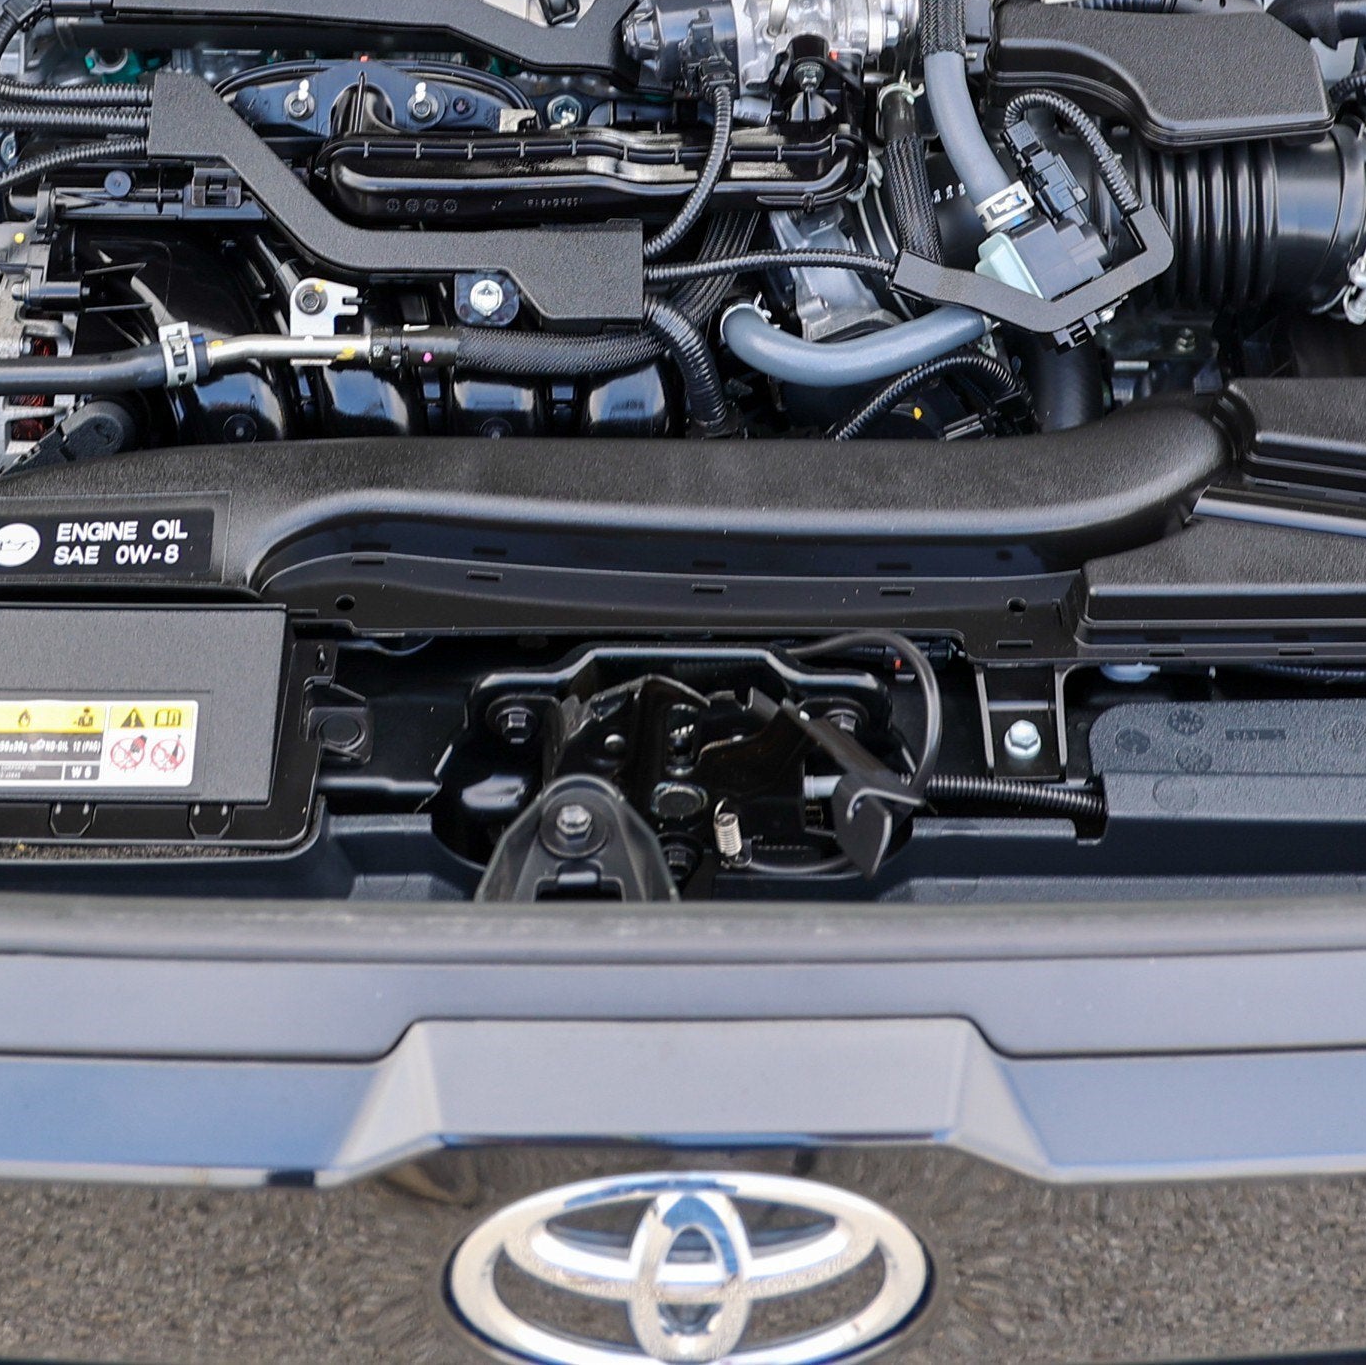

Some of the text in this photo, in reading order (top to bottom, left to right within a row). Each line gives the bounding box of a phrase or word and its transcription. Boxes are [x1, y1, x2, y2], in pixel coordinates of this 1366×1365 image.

[56, 519, 188, 543] ENGINE OIL
[53, 544, 180, 565] SAE 0W-8
